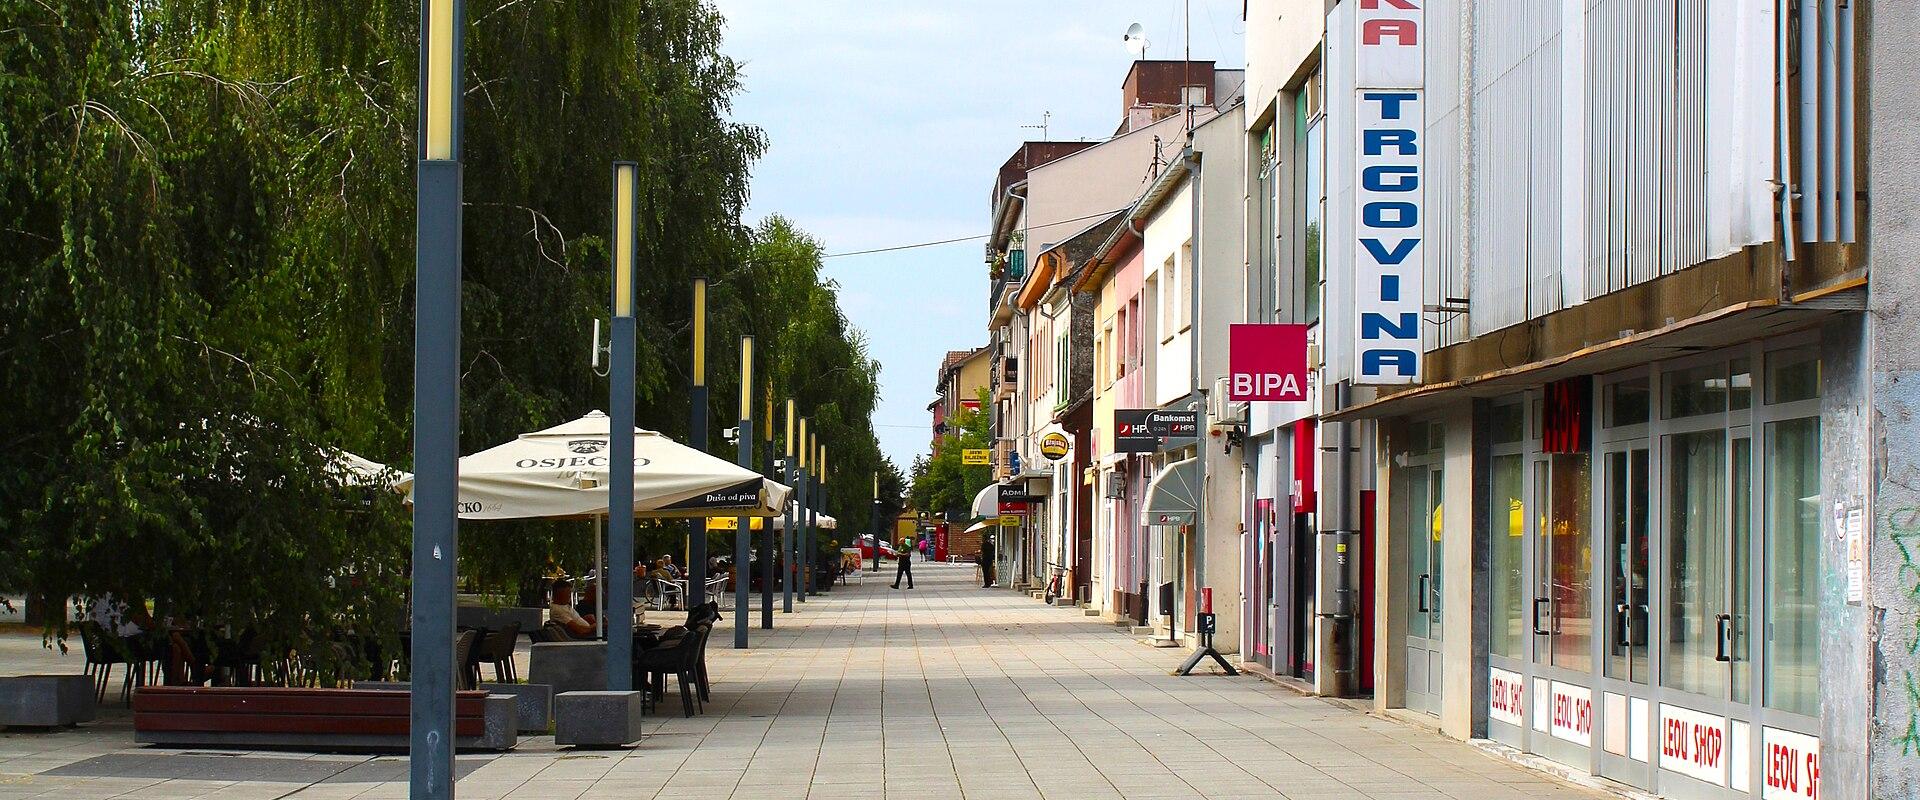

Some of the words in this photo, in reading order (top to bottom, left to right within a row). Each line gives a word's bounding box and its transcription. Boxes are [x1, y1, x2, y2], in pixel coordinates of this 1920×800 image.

[1359, 93, 1421, 377] TRGOVINA
[1234, 373, 1301, 396] BIPA
[1131, 424, 1149, 434] HP
[1153, 414, 1195, 422] Bankomat
[516, 456, 651, 469] OSJEČO
[706, 494, 726, 503] Duša
[728, 493, 738, 501] od
[739, 492, 756, 501] piva
[1206, 616, 1212, 624] P
[1492, 677, 1508, 711] LEOU
[1554, 693, 1572, 729] LEOU
[1663, 717, 1688, 760] LEOU
[1694, 723, 1722, 768] SHOP
[1767, 742, 1798, 792] LEOU
